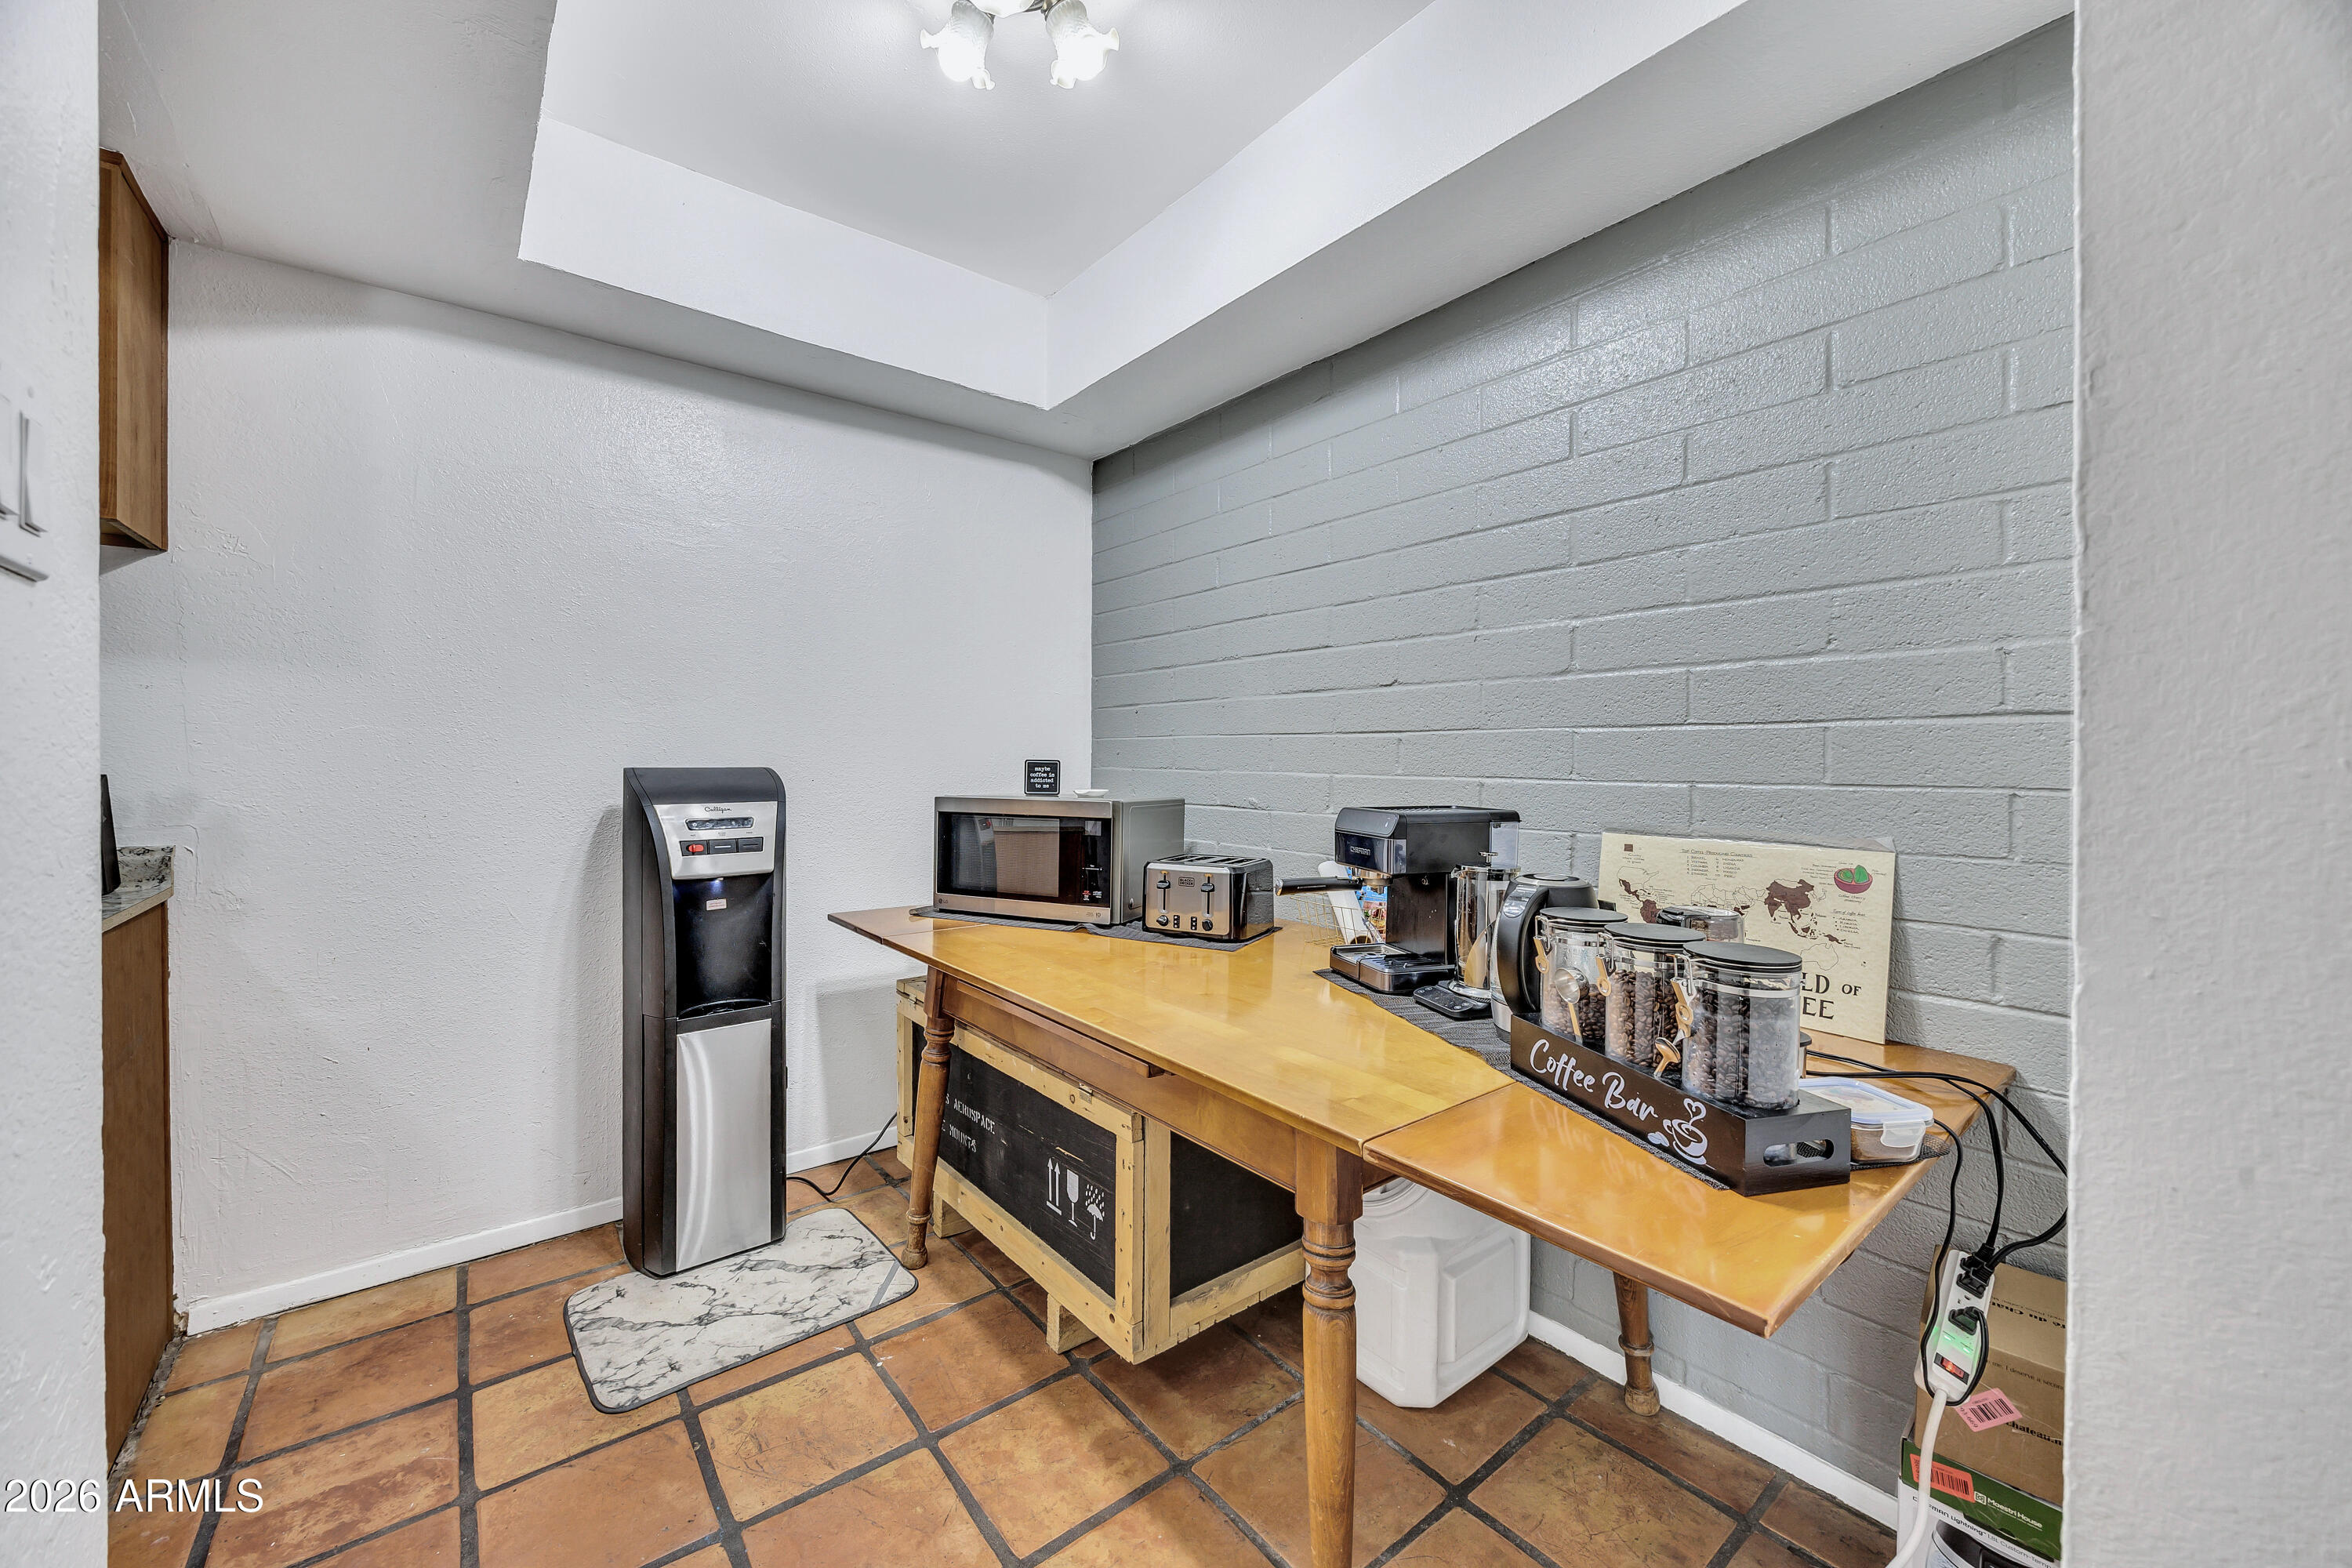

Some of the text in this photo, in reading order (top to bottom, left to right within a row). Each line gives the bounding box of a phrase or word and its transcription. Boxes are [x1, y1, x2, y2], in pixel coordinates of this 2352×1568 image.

[1802, 972, 1862, 996] LD OF
[1802, 996, 1835, 1020] EE
[1530, 1039, 1659, 1121] Coffee Bar
[954, 1098, 995, 1135] AEROSPACE
[1987, 1497, 2043, 1528] Maestri House
